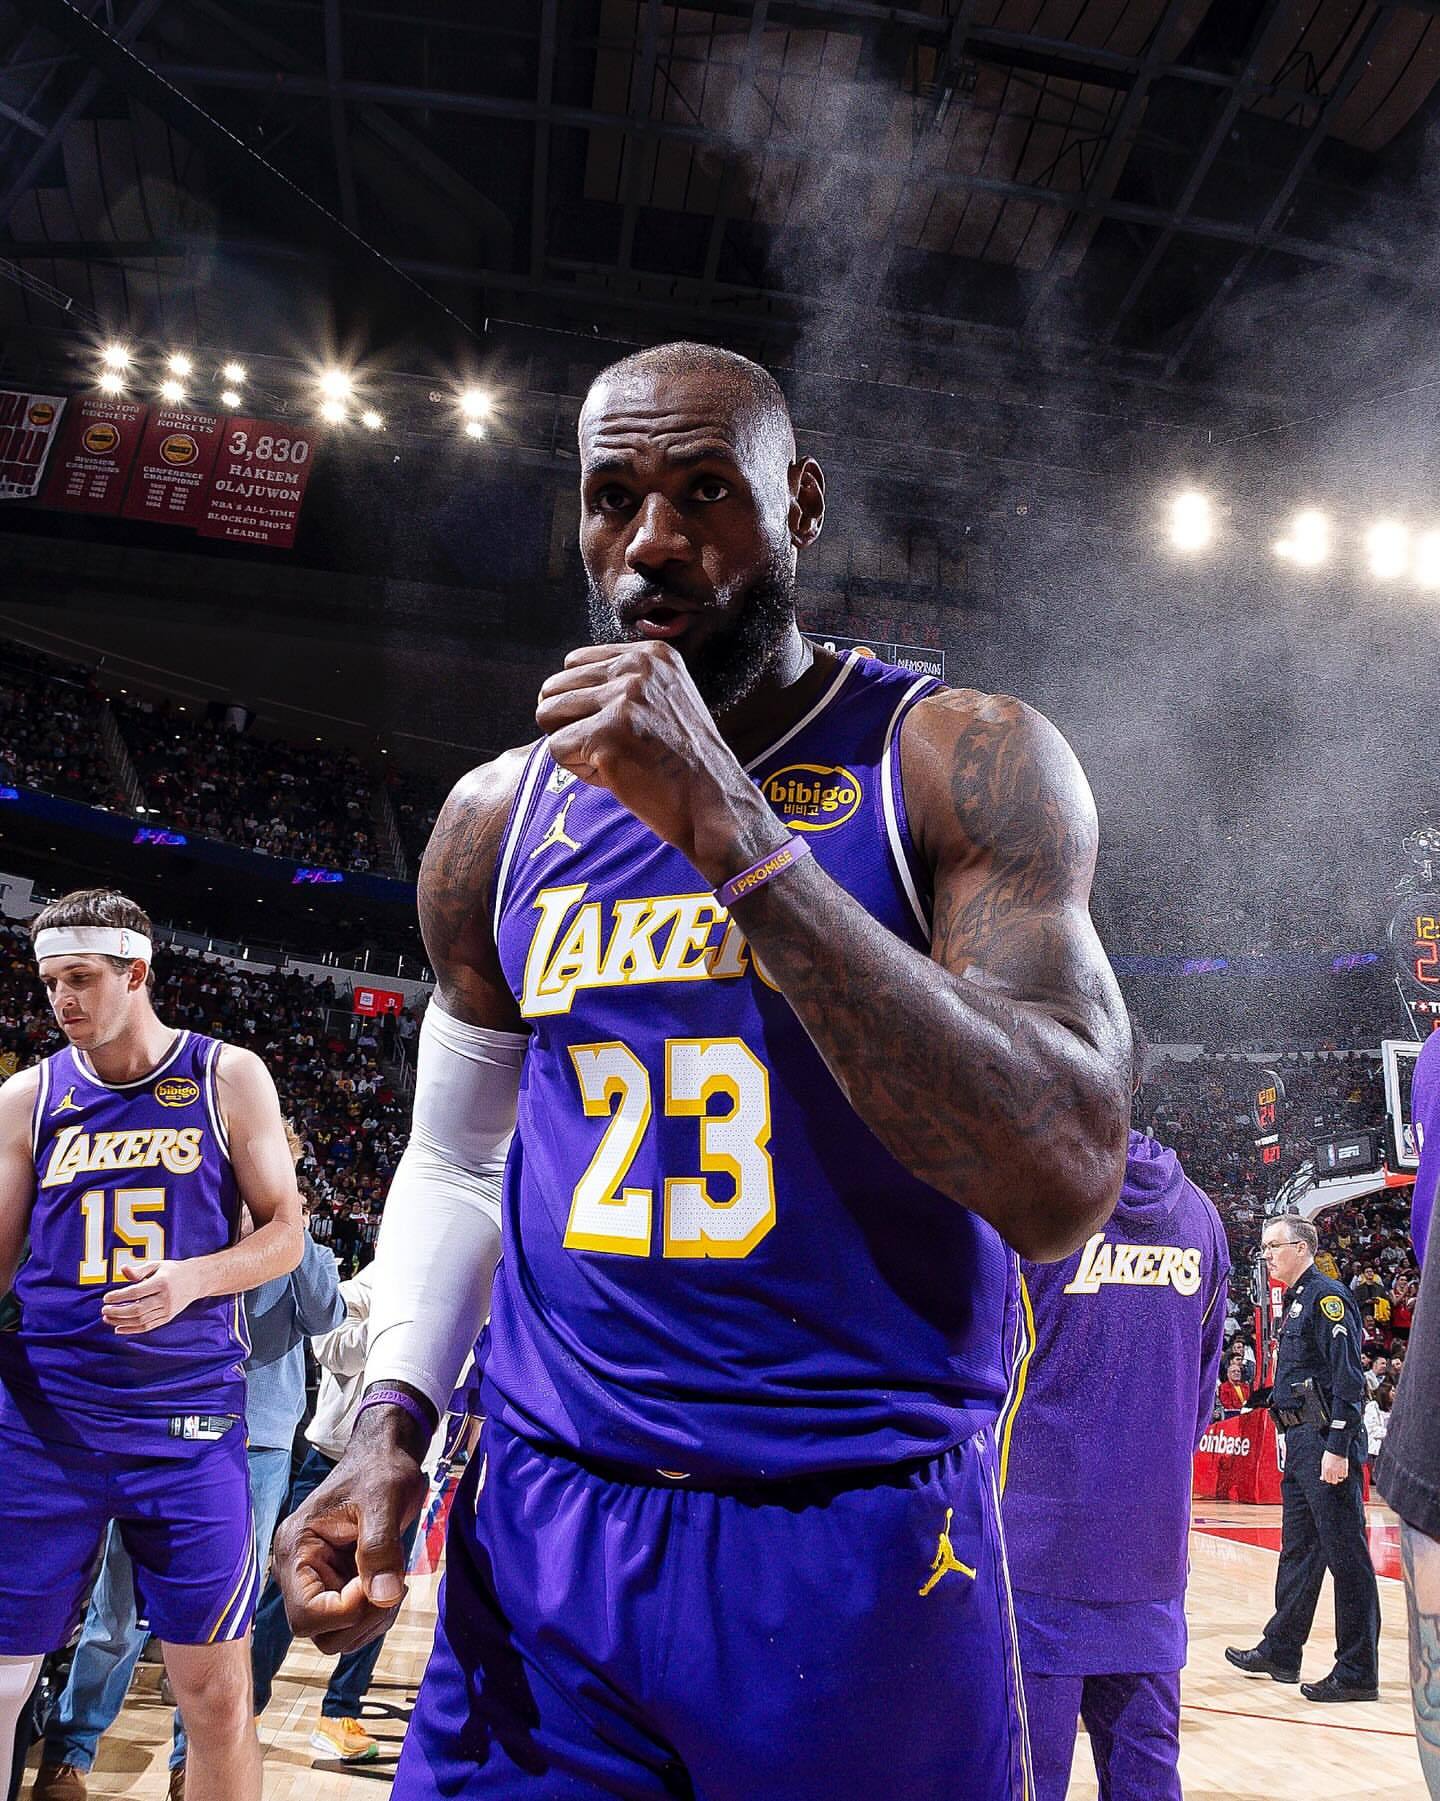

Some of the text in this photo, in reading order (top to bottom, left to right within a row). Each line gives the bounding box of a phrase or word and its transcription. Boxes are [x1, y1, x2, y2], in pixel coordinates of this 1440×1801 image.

[156, 419, 214, 433] ROCKETS
[228, 431, 308, 464] 3,830
[143, 466, 205, 479] CONFERENCE
[143, 473, 200, 486] CHAMPIONS
[229, 464, 299, 484] HAKEEM
[215, 479, 301, 501] OLAJUWON
[207, 512, 257, 525] BLOCKED
[225, 527, 269, 540] LEADER
[771, 780, 856, 812] bibigo
[784, 803, 819, 816] 비비고
[737, 850, 793, 892] PROMISE
[521, 883, 782, 1017] LAKE
[159, 1085, 197, 1098] bibigo
[42, 1125, 203, 1189] LAKERS
[563, 1036, 777, 1258] 23
[79, 1187, 167, 1285] 15
[1063, 1232, 1202, 1296] LAKERS
[1199, 1429, 1250, 1456] oinbase
